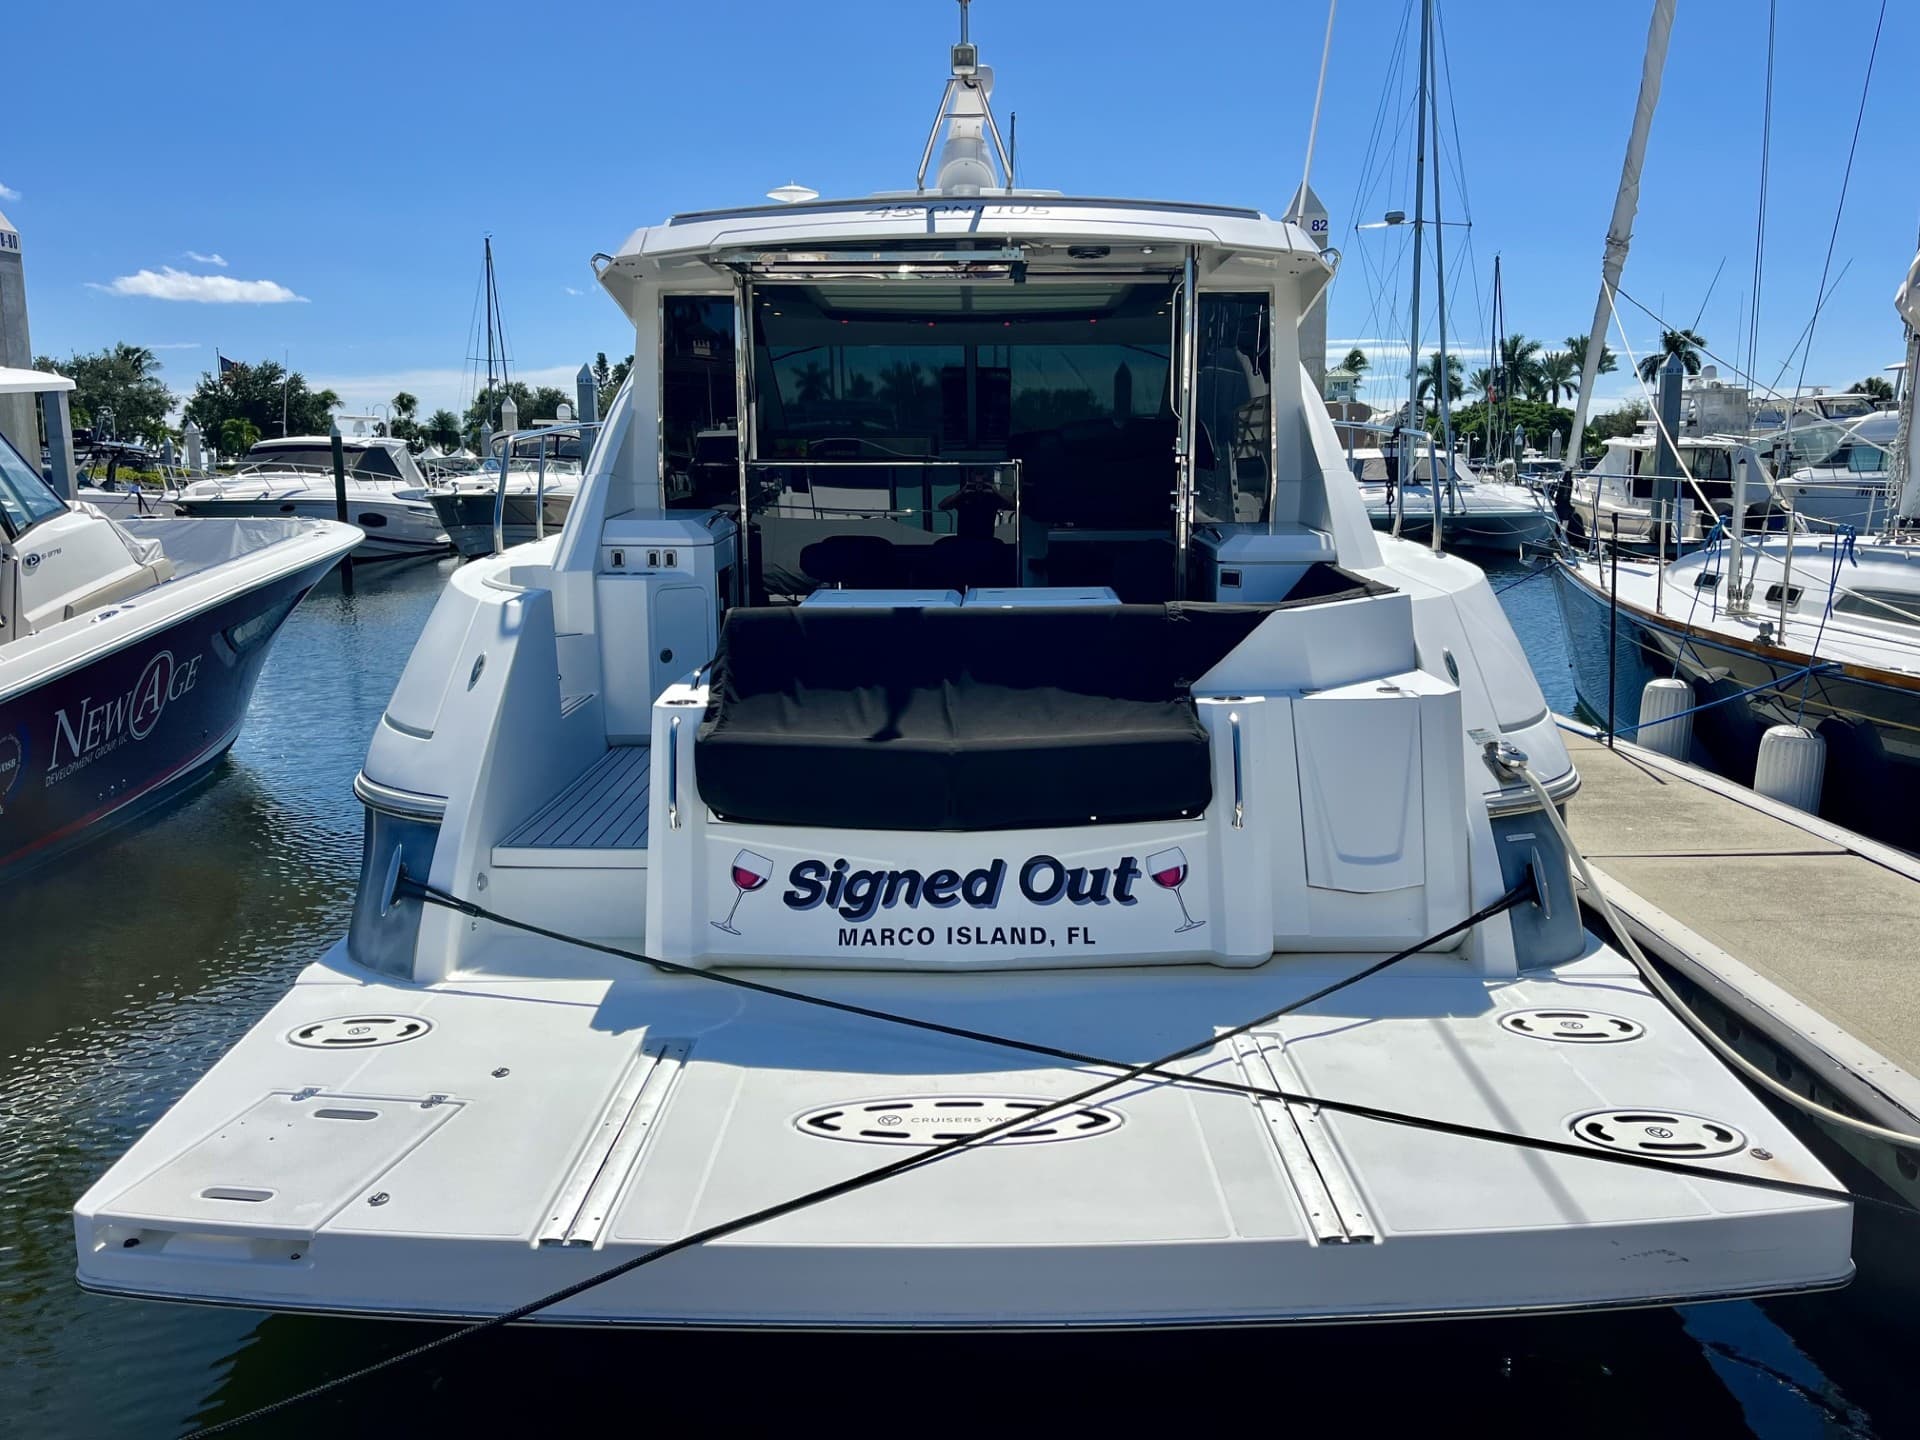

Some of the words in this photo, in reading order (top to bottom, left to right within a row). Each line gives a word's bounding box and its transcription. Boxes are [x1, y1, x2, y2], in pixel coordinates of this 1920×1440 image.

[1311, 219, 1328, 231] 82
[45, 752, 95, 788] DEVELOPMENT
[783, 858, 1007, 923] Signed
[1019, 854, 1142, 906] Out
[838, 927, 935, 947] MARCO
[947, 926, 1056, 947] ISLAND,
[1067, 926, 1096, 945] FL
